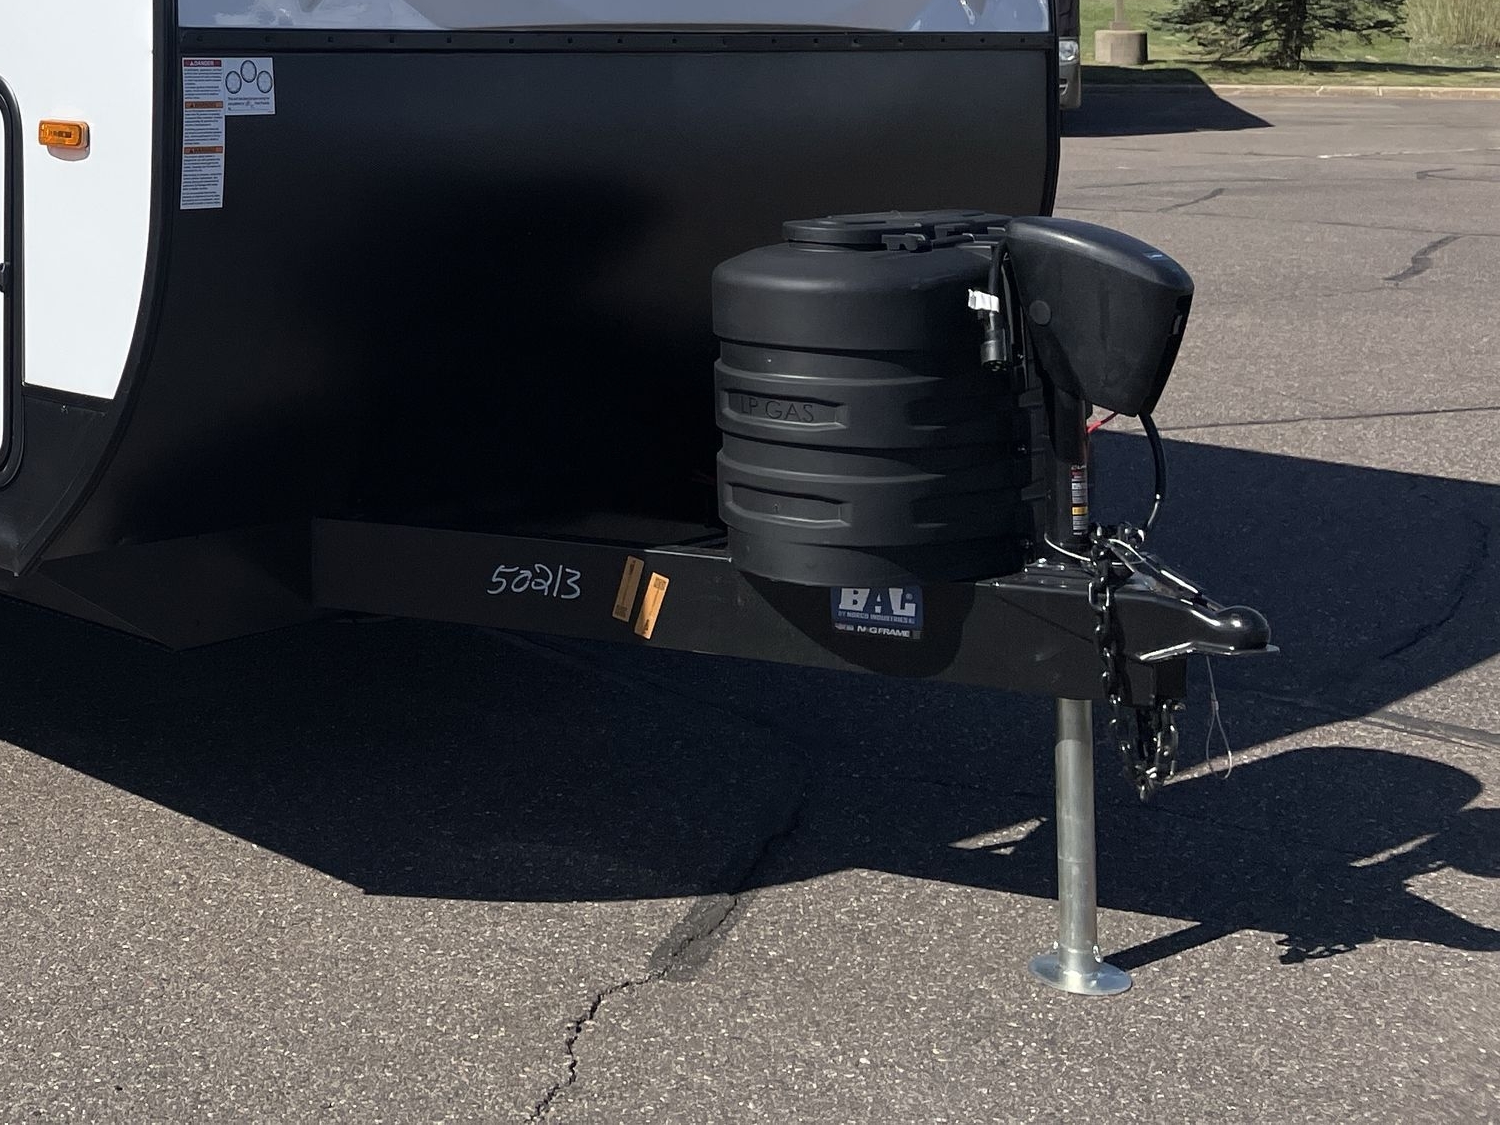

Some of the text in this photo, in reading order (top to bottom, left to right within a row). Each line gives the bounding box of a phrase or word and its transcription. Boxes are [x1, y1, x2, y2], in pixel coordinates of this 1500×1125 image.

[740, 396, 814, 423] LP GAS
[486, 563, 582, 600] 50213
[870, 614, 908, 624] INDUSTRIES
